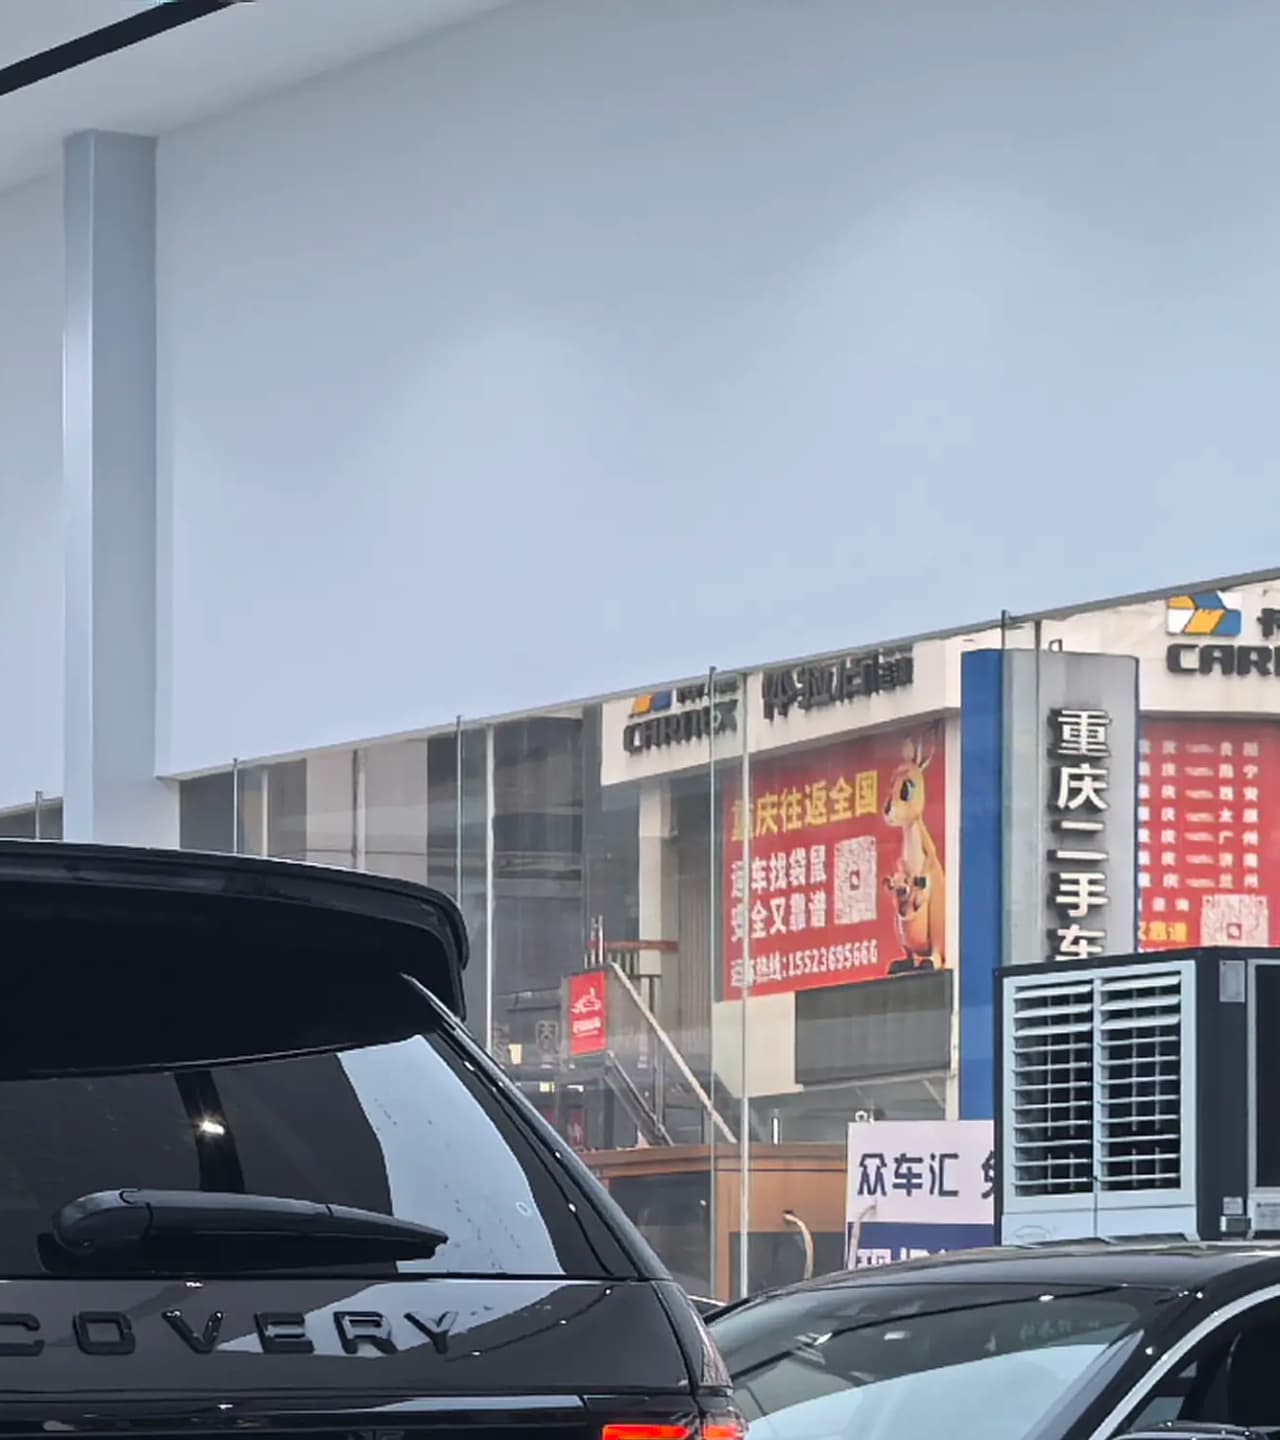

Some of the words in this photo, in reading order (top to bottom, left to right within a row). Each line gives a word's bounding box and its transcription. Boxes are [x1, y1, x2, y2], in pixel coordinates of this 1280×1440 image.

[1166, 643, 1280, 677] CAR
[1052, 708, 1111, 961] 重庆二手车
[857, 1152, 959, 1198] 众车汇
